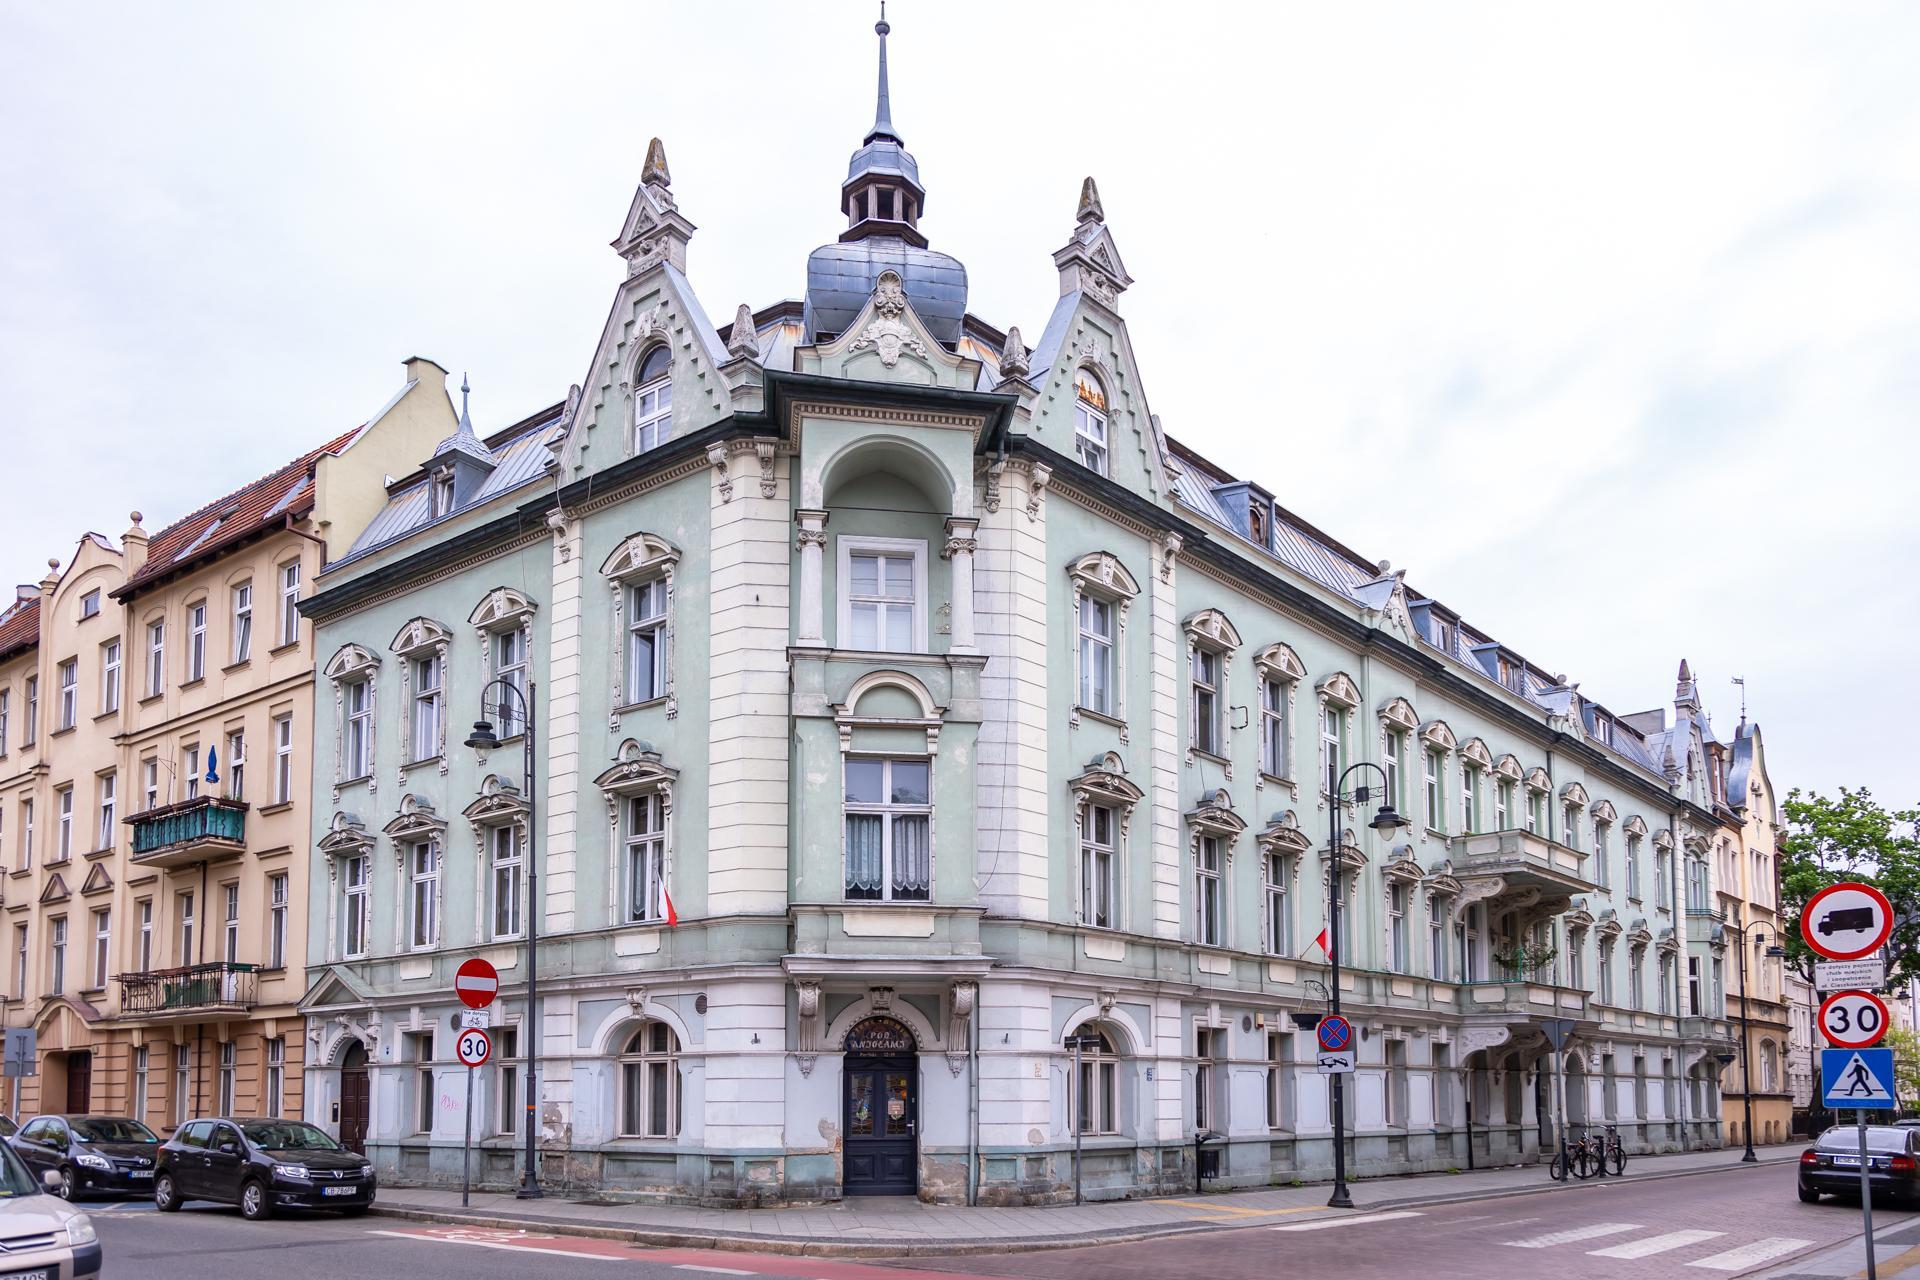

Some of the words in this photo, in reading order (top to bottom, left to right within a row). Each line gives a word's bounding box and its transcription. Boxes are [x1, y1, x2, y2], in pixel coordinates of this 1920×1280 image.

[472, 1010, 489, 1018] dotyczy
[1829, 1005, 1879, 1034] 30
[870, 1031, 890, 1039] POD
[463, 1038, 487, 1057] 30
